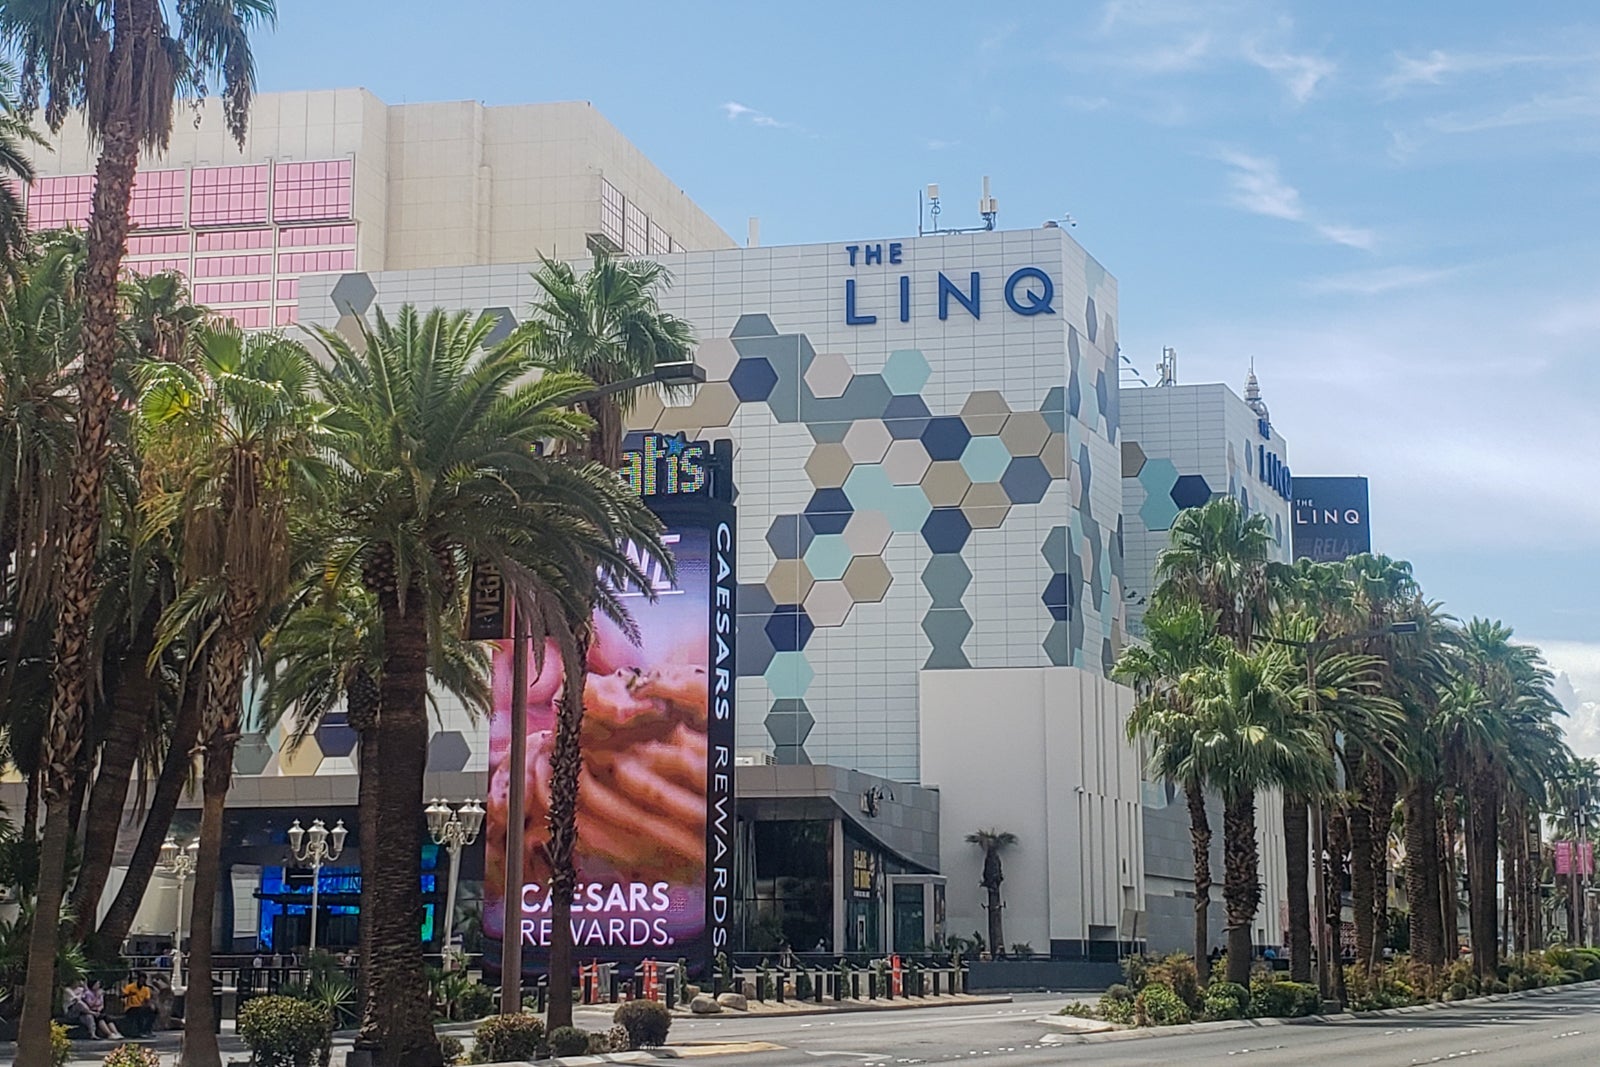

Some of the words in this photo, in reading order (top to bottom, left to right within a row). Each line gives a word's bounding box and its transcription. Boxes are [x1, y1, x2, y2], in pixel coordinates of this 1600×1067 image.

[846, 243, 902, 267] THE
[846, 267, 1056, 325] LINQ
[618, 436, 704, 495] atis
[1296, 499, 1313, 507] THE
[1296, 509, 1359, 524] LINQ
[475, 557, 501, 619] VEGA
[714, 522, 732, 721] CAESARS
